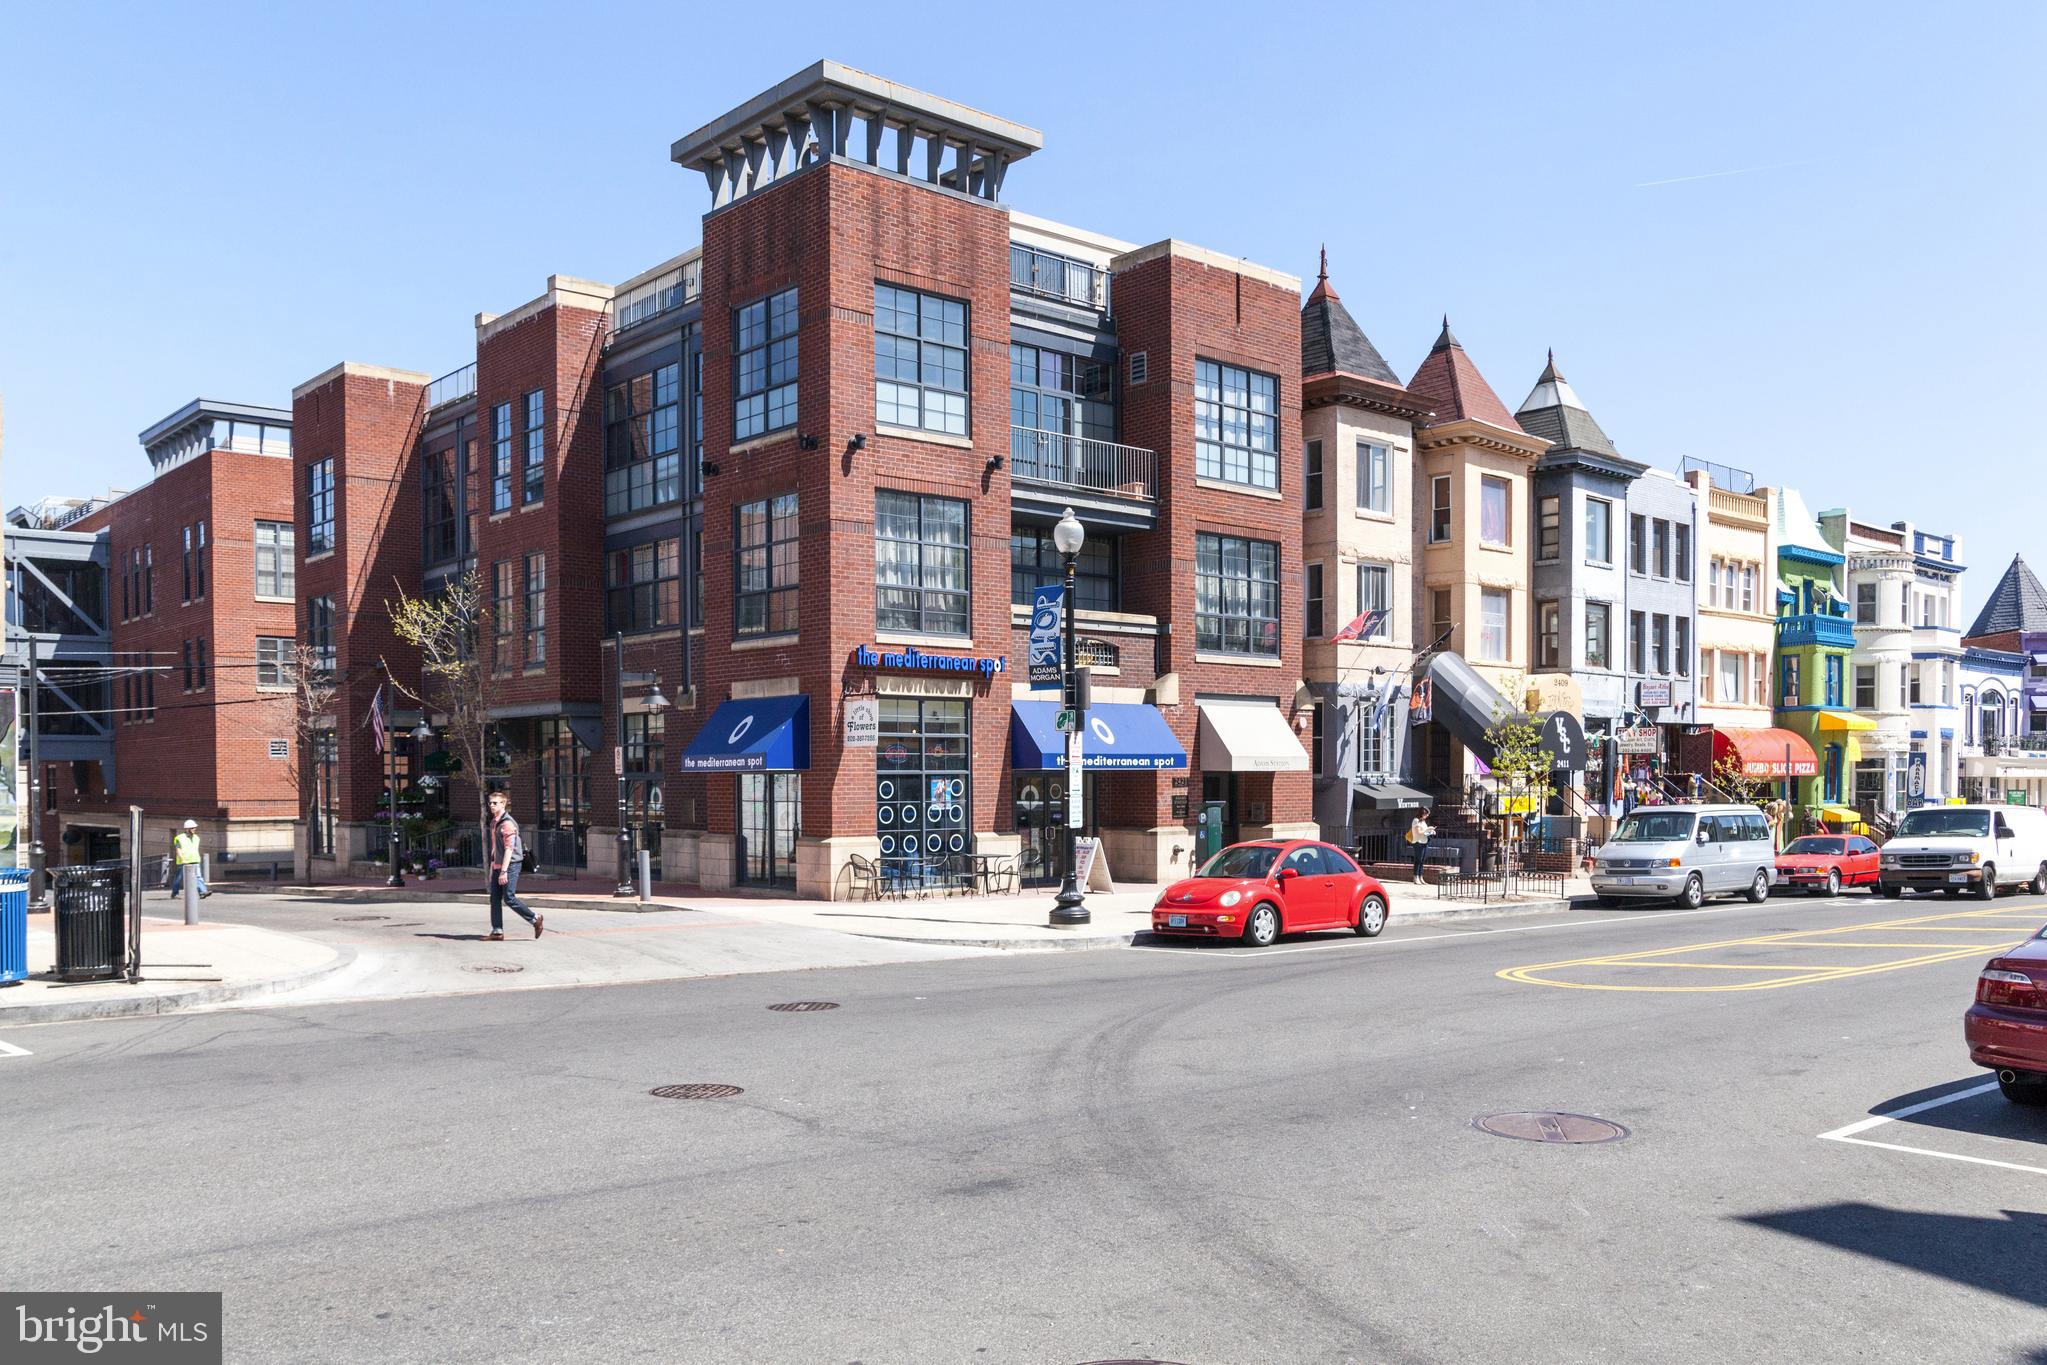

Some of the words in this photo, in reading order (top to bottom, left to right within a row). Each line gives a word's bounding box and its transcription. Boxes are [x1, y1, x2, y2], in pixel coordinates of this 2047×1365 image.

[1031, 595, 1060, 664] SHOP
[856, 644, 878, 666] the
[883, 646, 976, 671] mediterranean
[979, 656, 1006, 679] spot
[1554, 679, 1569, 687] 2409
[859, 713, 865, 721] of
[847, 721, 876, 732] Flowers
[1639, 728, 1657, 737] SHOP
[685, 757, 695, 767] the
[698, 757, 745, 767] mediterranean
[748, 756, 763, 769] spot
[1154, 757, 1174, 768] spot
[1557, 760, 1569, 768] 2411
[1745, 762, 1769, 774] JUMBO
[1795, 762, 1816, 774] PIZZA
[1907, 798, 1924, 807] BAR
